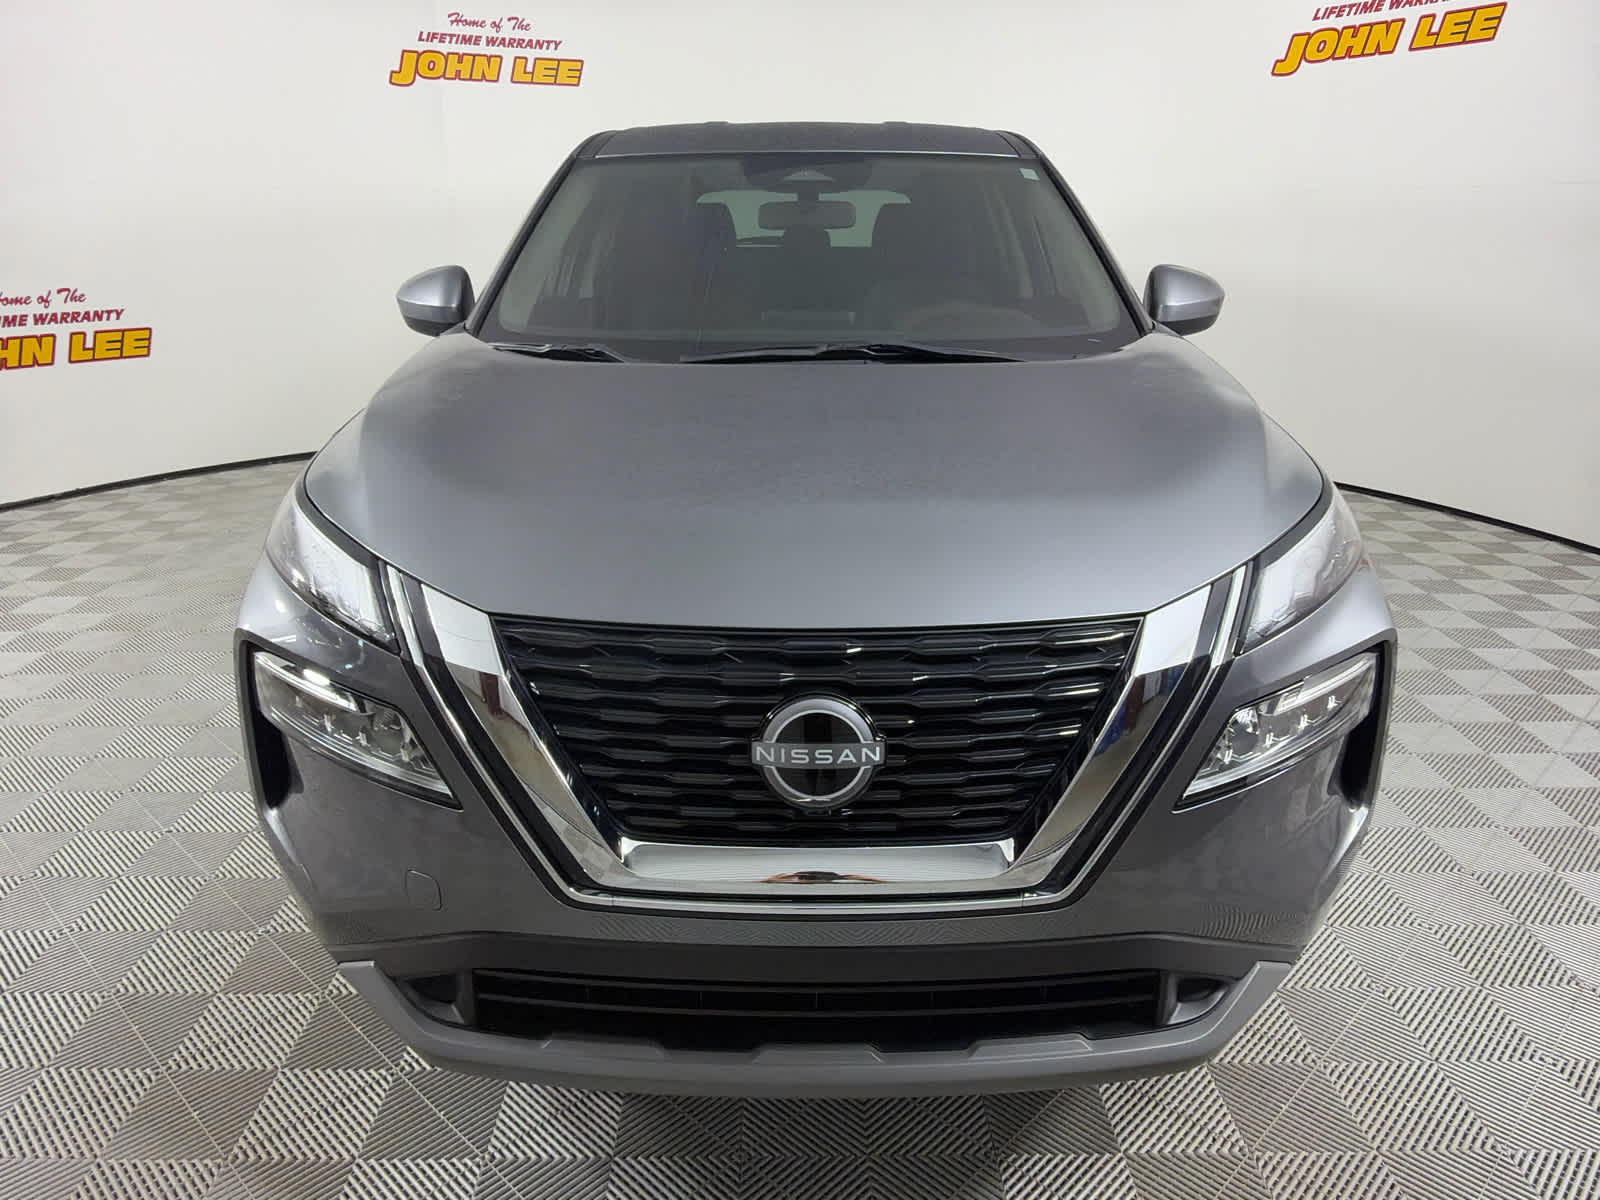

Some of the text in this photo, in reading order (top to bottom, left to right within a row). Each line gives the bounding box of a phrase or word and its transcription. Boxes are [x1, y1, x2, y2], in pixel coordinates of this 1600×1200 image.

[1312, 0, 1385, 21] LIFETIME
[448, 12, 532, 33] Home of The
[417, 31, 562, 51] LIFETIME WARRANTY
[1271, 2, 1508, 76] JOHN LEE
[389, 49, 584, 86] JOHN LEE
[0, 288, 87, 309] ome of The
[33, 309, 124, 326] WARRANTY
[0, 327, 152, 370] HN LEE
[756, 746, 880, 764] NISSAN
